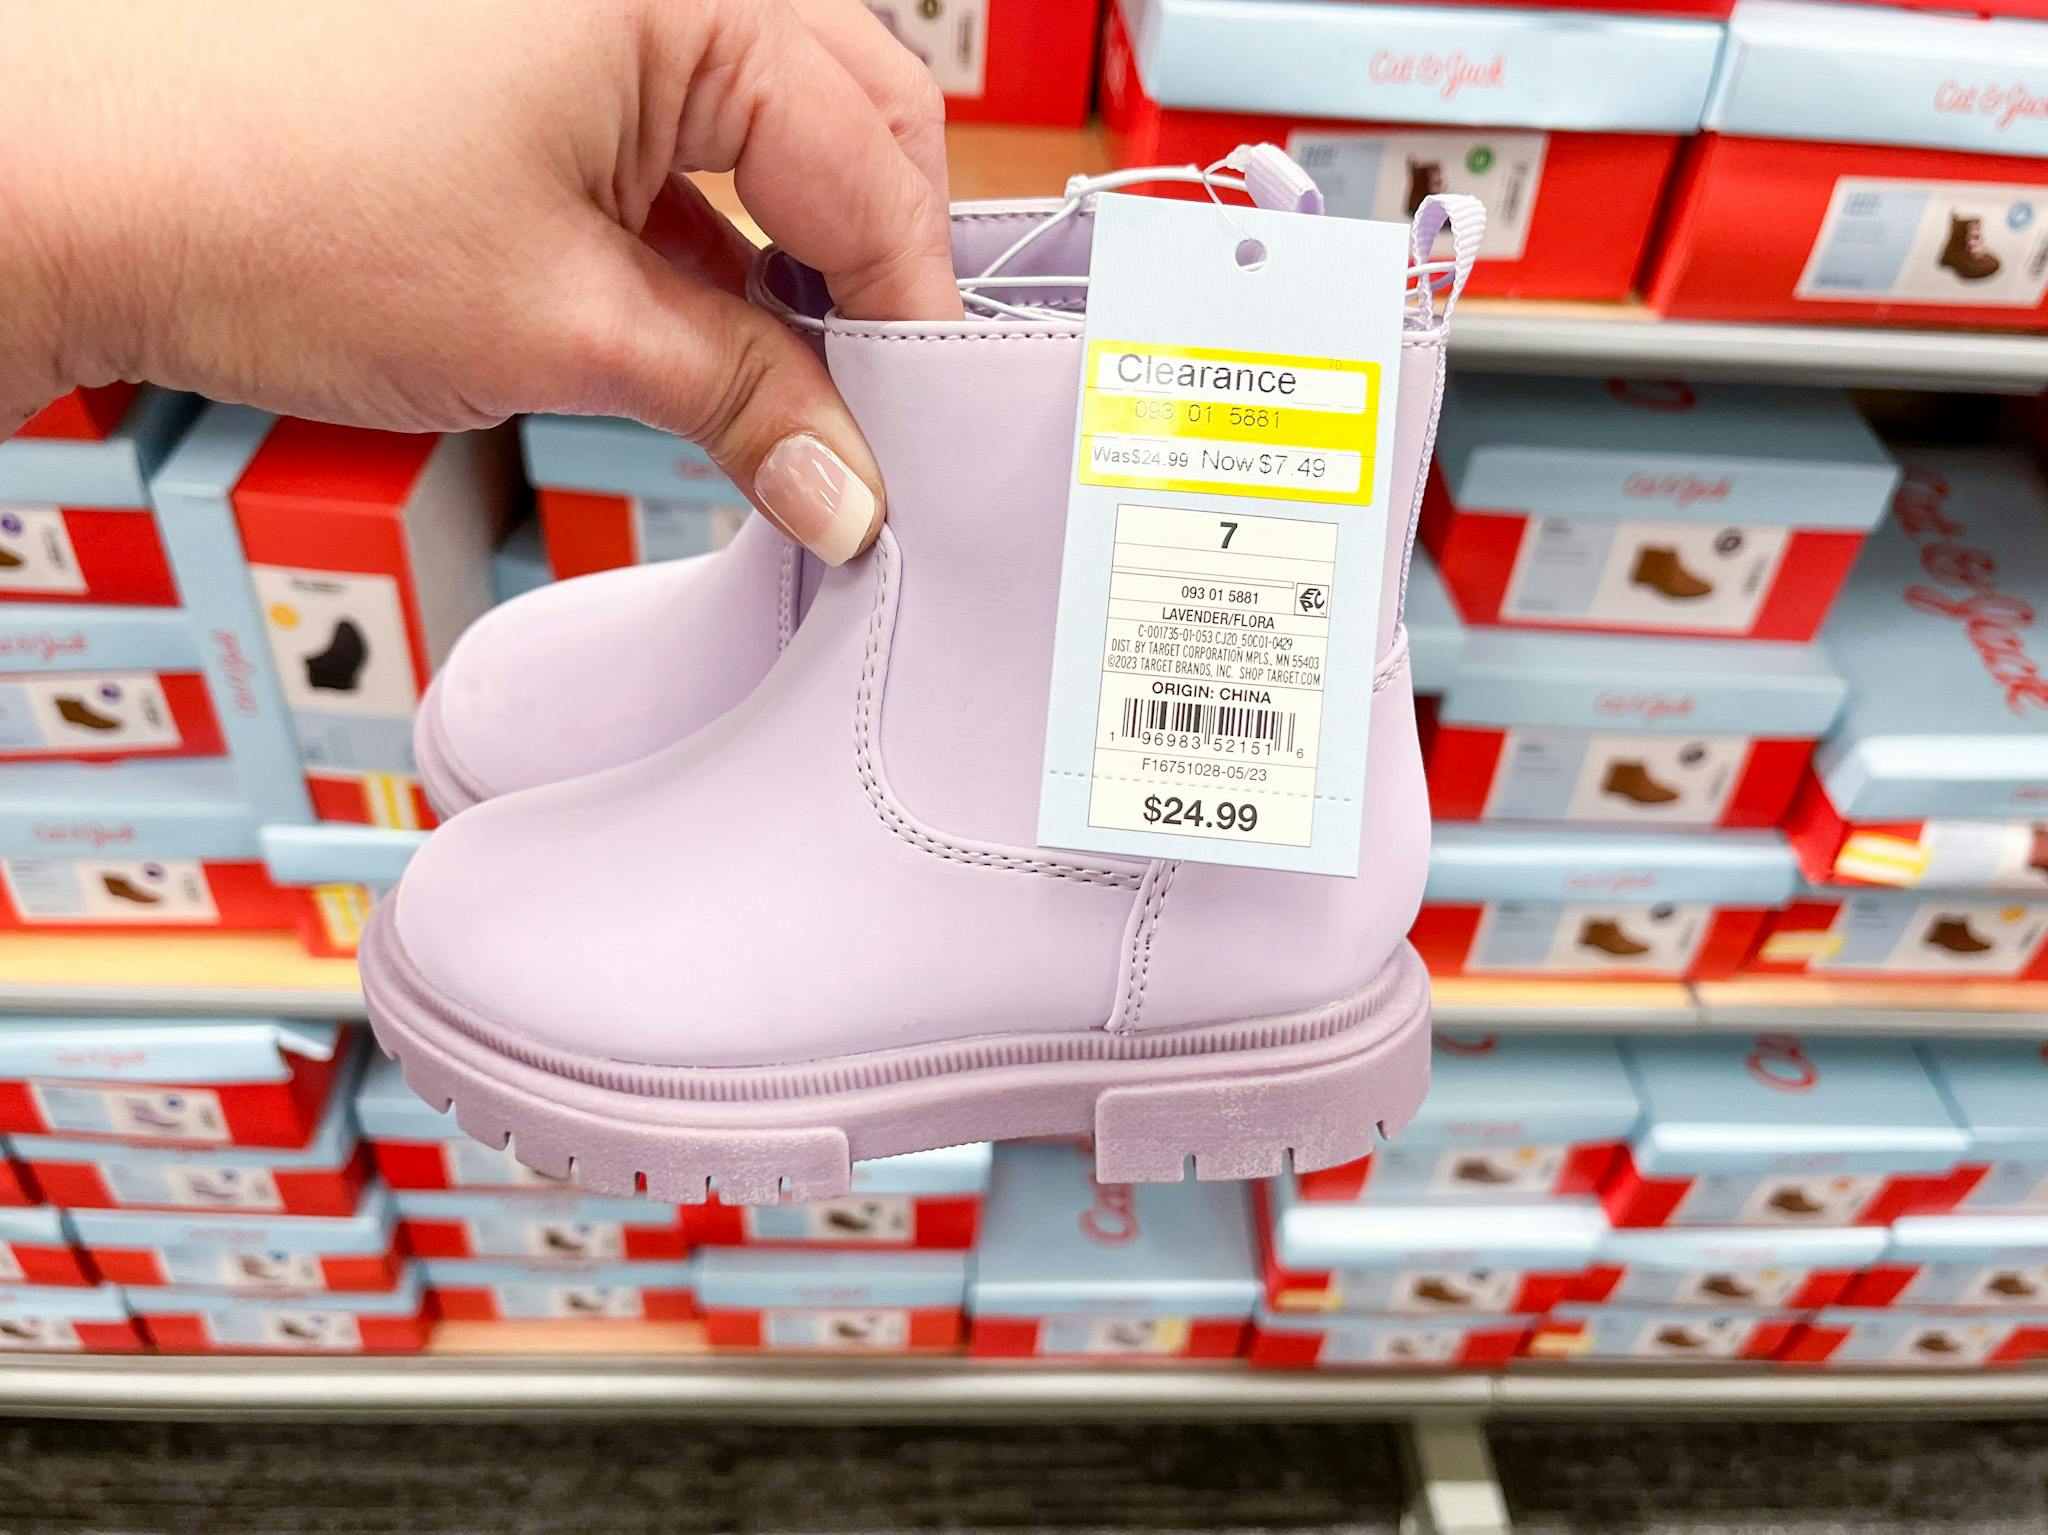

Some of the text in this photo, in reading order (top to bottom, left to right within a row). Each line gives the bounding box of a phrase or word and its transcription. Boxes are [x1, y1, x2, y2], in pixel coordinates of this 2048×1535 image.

[1118, 354, 1296, 394] Clearance
[1135, 401, 1280, 428] 093 01 5881
[1203, 450, 1253, 471] Now
[1220, 522, 1238, 549] 7
[1182, 586, 1259, 604] 093 01 5881
[1162, 607, 1275, 629] LAVENDER/FLORA
[1138, 625, 1213, 643] C-001735-01-053
[1111, 639, 1132, 652] DIST.
[1135, 642, 1146, 654] BY
[1148, 642, 1179, 657] TARGET
[1182, 647, 1243, 662] CORPORATION
[1275, 654, 1289, 667] MN
[1292, 656, 1319, 669] 55403
[1107, 655, 1320, 686] ©2023 TARGET BRANDS, INC. SHOP TARGET.COM
[1152, 682, 1271, 704] ORIGIN: CHINA
[1109, 731, 1304, 759] 1 96983 52151 6
[1142, 758, 1267, 782] F16751028-05/23
[1143, 794, 1258, 831] $24.99
